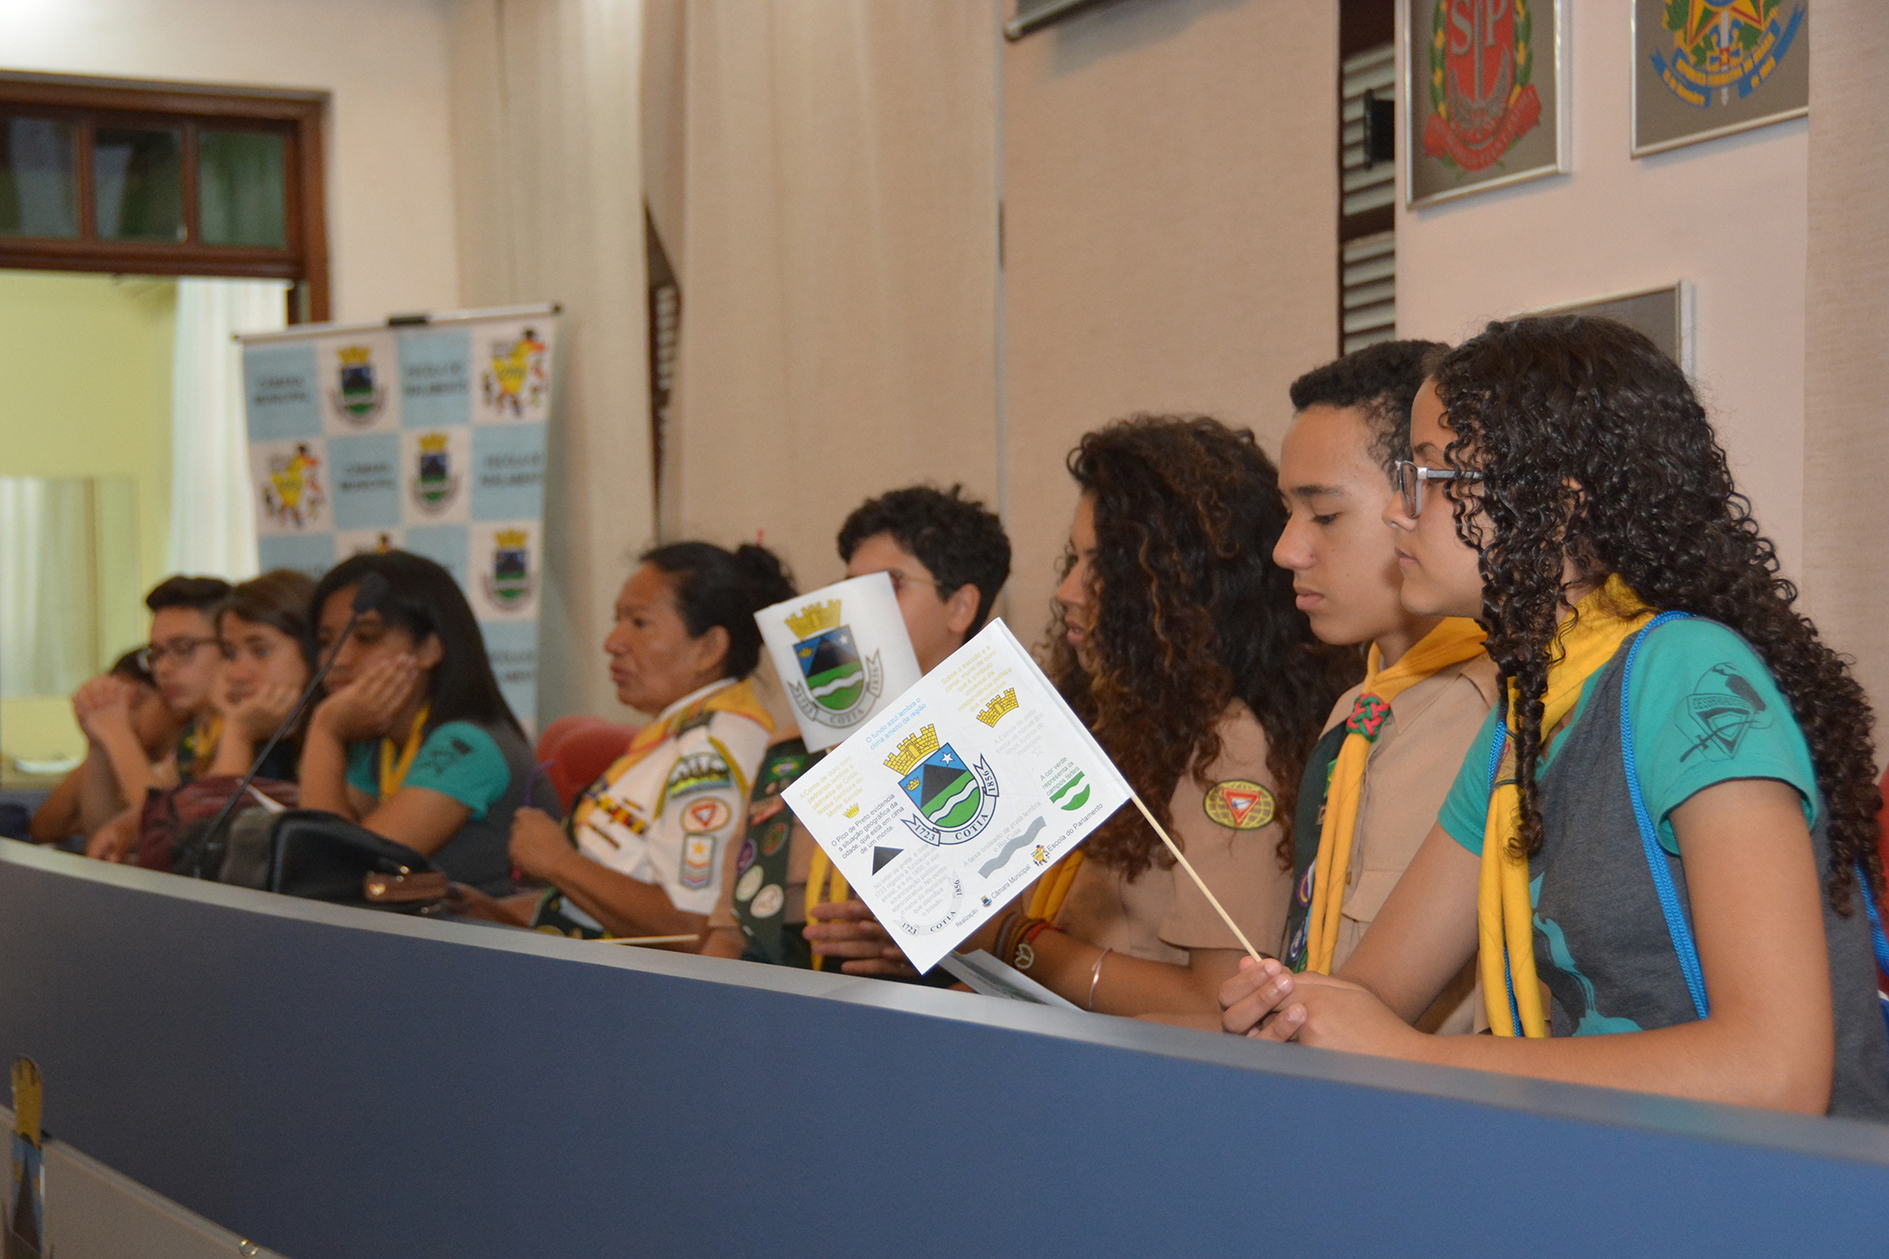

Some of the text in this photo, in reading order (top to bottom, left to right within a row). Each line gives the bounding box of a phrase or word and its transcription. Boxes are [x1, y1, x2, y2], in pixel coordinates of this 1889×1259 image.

[941, 670, 958, 685] Sobre
[961, 651, 982, 669] escudo
[829, 708, 864, 724] COTIA
[870, 703, 927, 750] clima ameno da região
[871, 724, 888, 739] fundo
[886, 715, 899, 726] azul
[898, 700, 917, 717] lembra
[803, 781, 820, 796] Coroa
[819, 775, 828, 783] de
[828, 765, 841, 777] ouro
[840, 756, 852, 767] com
[982, 769, 996, 792] 1856
[1042, 766, 1068, 789] representa
[1045, 768, 1053, 777] cor
[1053, 756, 1067, 769] verde
[1046, 765, 1080, 797] campos férteis
[836, 830, 849, 842] Pico
[847, 824, 856, 833] de
[855, 813, 871, 827] Preto
[869, 793, 895, 815] evidencia
[842, 829, 865, 849] situação
[863, 807, 891, 832] geográfica
[889, 801, 898, 809] da
[860, 834, 871, 845] que
[870, 824, 882, 836] está
[882, 817, 891, 826] em
[890, 806, 904, 819] cima
[915, 822, 936, 841] 1723
[955, 814, 988, 840] COTIA
[860, 846, 868, 854] de
[868, 839, 877, 848] um
[991, 881, 1010, 899] Câmara
[1008, 864, 1031, 885] Municipal
[1047, 834, 1067, 852] Escola
[1065, 827, 1074, 837] do
[1073, 802, 1104, 830] Parlamento
[902, 923, 917, 934] 1723
[930, 911, 955, 932] COTIA
